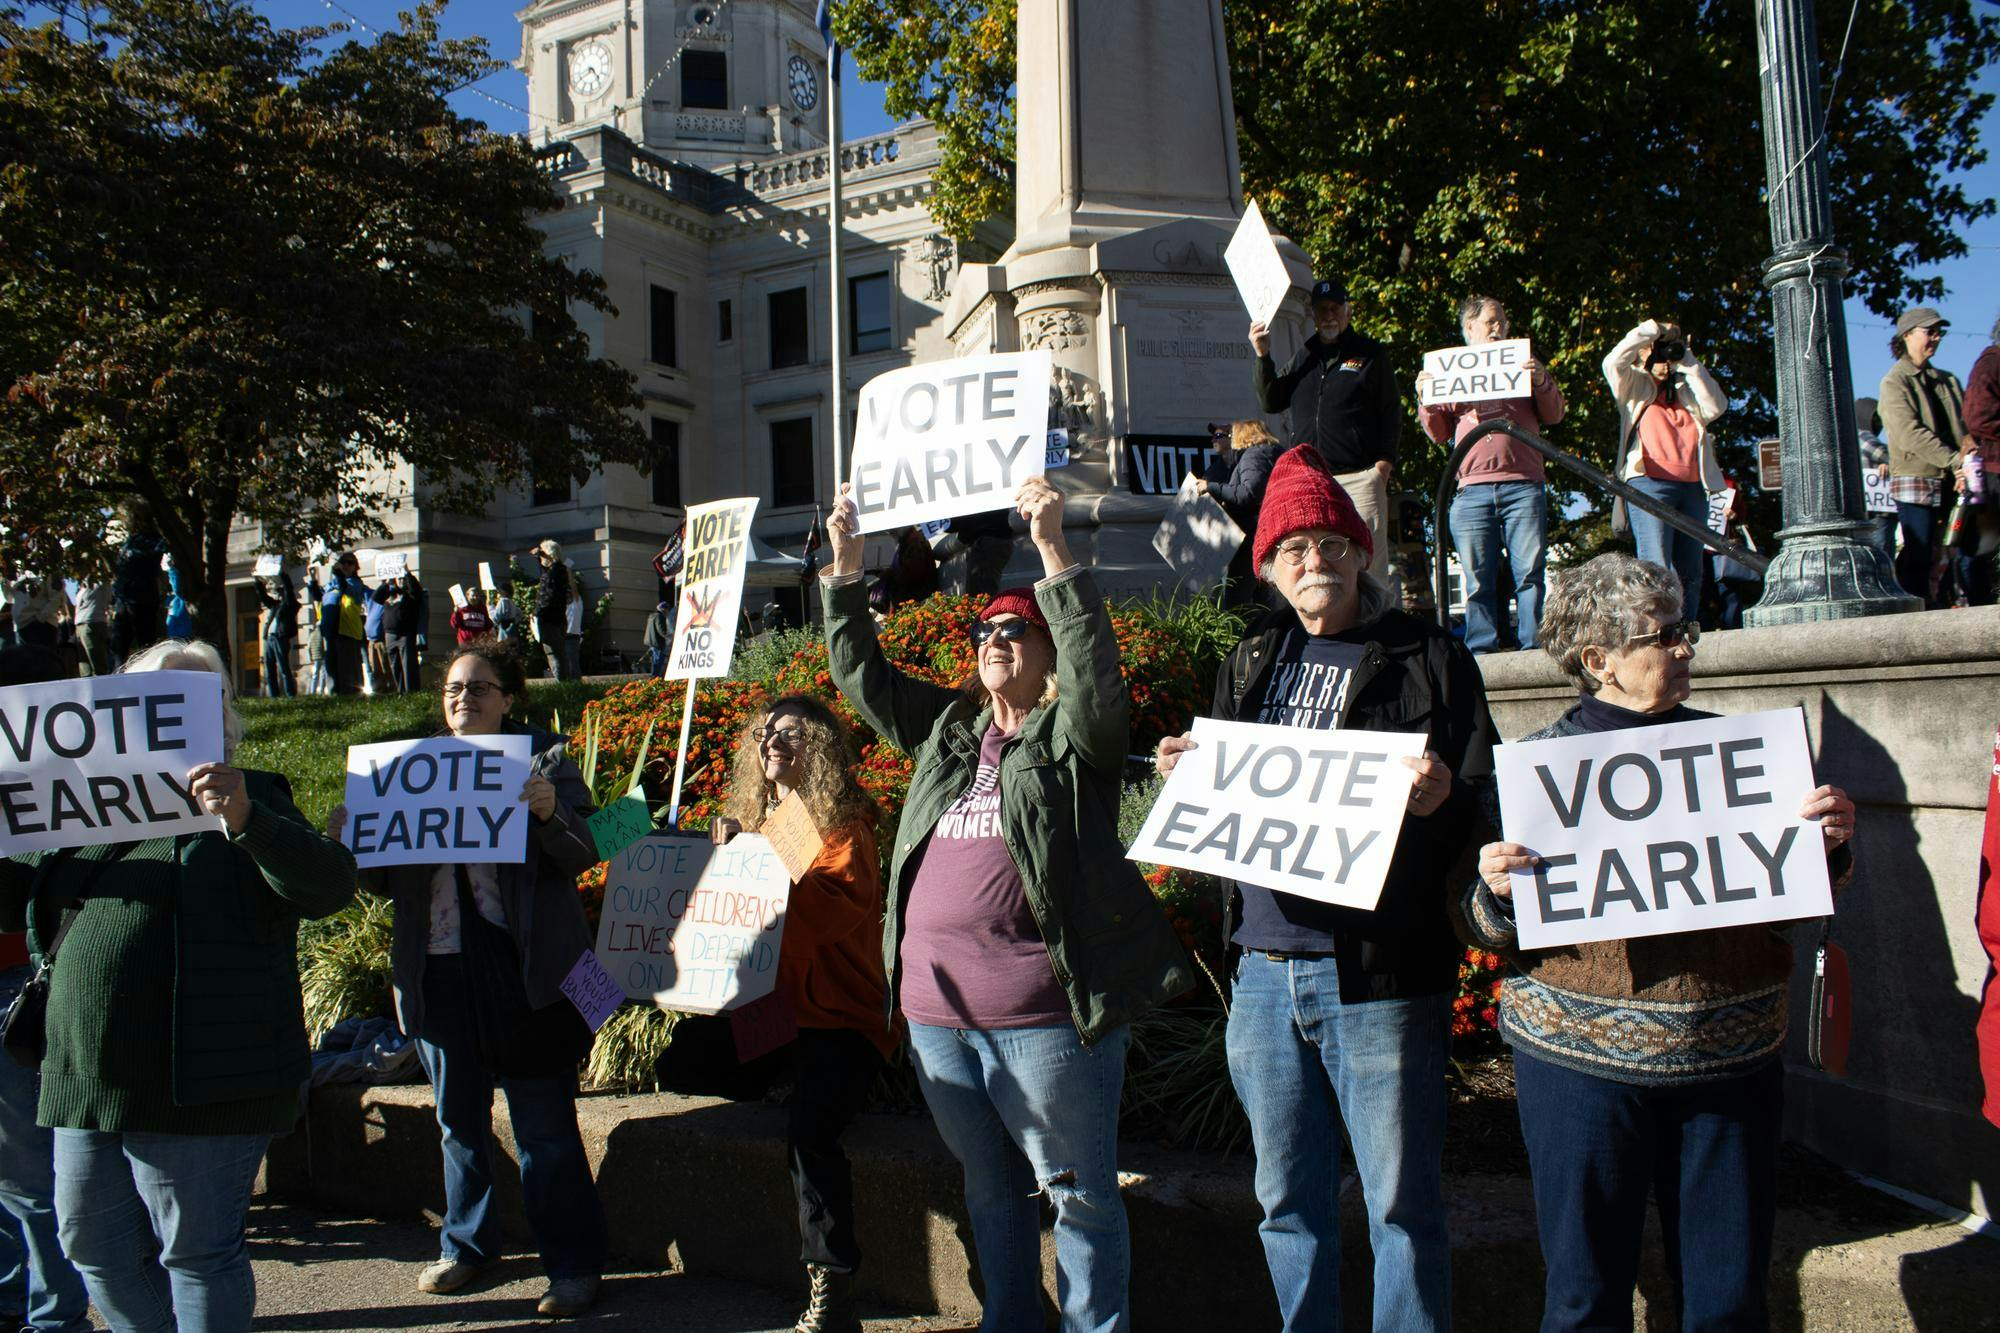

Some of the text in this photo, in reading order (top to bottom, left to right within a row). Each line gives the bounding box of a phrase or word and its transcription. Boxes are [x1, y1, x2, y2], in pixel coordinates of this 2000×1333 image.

[1438, 347, 1516, 372] VOTE
[868, 370, 1018, 440] VOTE
[1432, 371, 1522, 397] EARLY
[1045, 449, 1065, 465] RLY
[1047, 433, 1061, 447] TE
[855, 434, 1031, 515] EARLY
[1708, 491, 1729, 532] ARLY
[1864, 491, 1895, 507] ARL
[691, 505, 747, 551] VOTE
[377, 567, 403, 577] EARLY
[685, 541, 743, 587] EARLY
[678, 651, 716, 669] KINGS
[685, 630, 712, 652] NO
[0, 694, 187, 762] VOTE
[369, 750, 504, 797] VOTE
[1213, 740, 1388, 807] VOTE
[1534, 737, 1772, 828] VOTE
[0, 771, 204, 835] EARLY
[352, 806, 515, 855] EARLY
[604, 822, 641, 857] PLAN
[616, 821, 627, 834] A
[1153, 801, 1381, 884] EARLY
[625, 844, 775, 881] VOTE LIKE
[1533, 826, 1799, 924] EARLY
[613, 885, 660, 915] OUR
[608, 921, 773, 972] LIVES DEPEND
[581, 973, 606, 1010] YOUR
[583, 953, 619, 1000] KNOW
[628, 961, 735, 1004] ON IT!
[562, 977, 600, 1021] BALLOT
